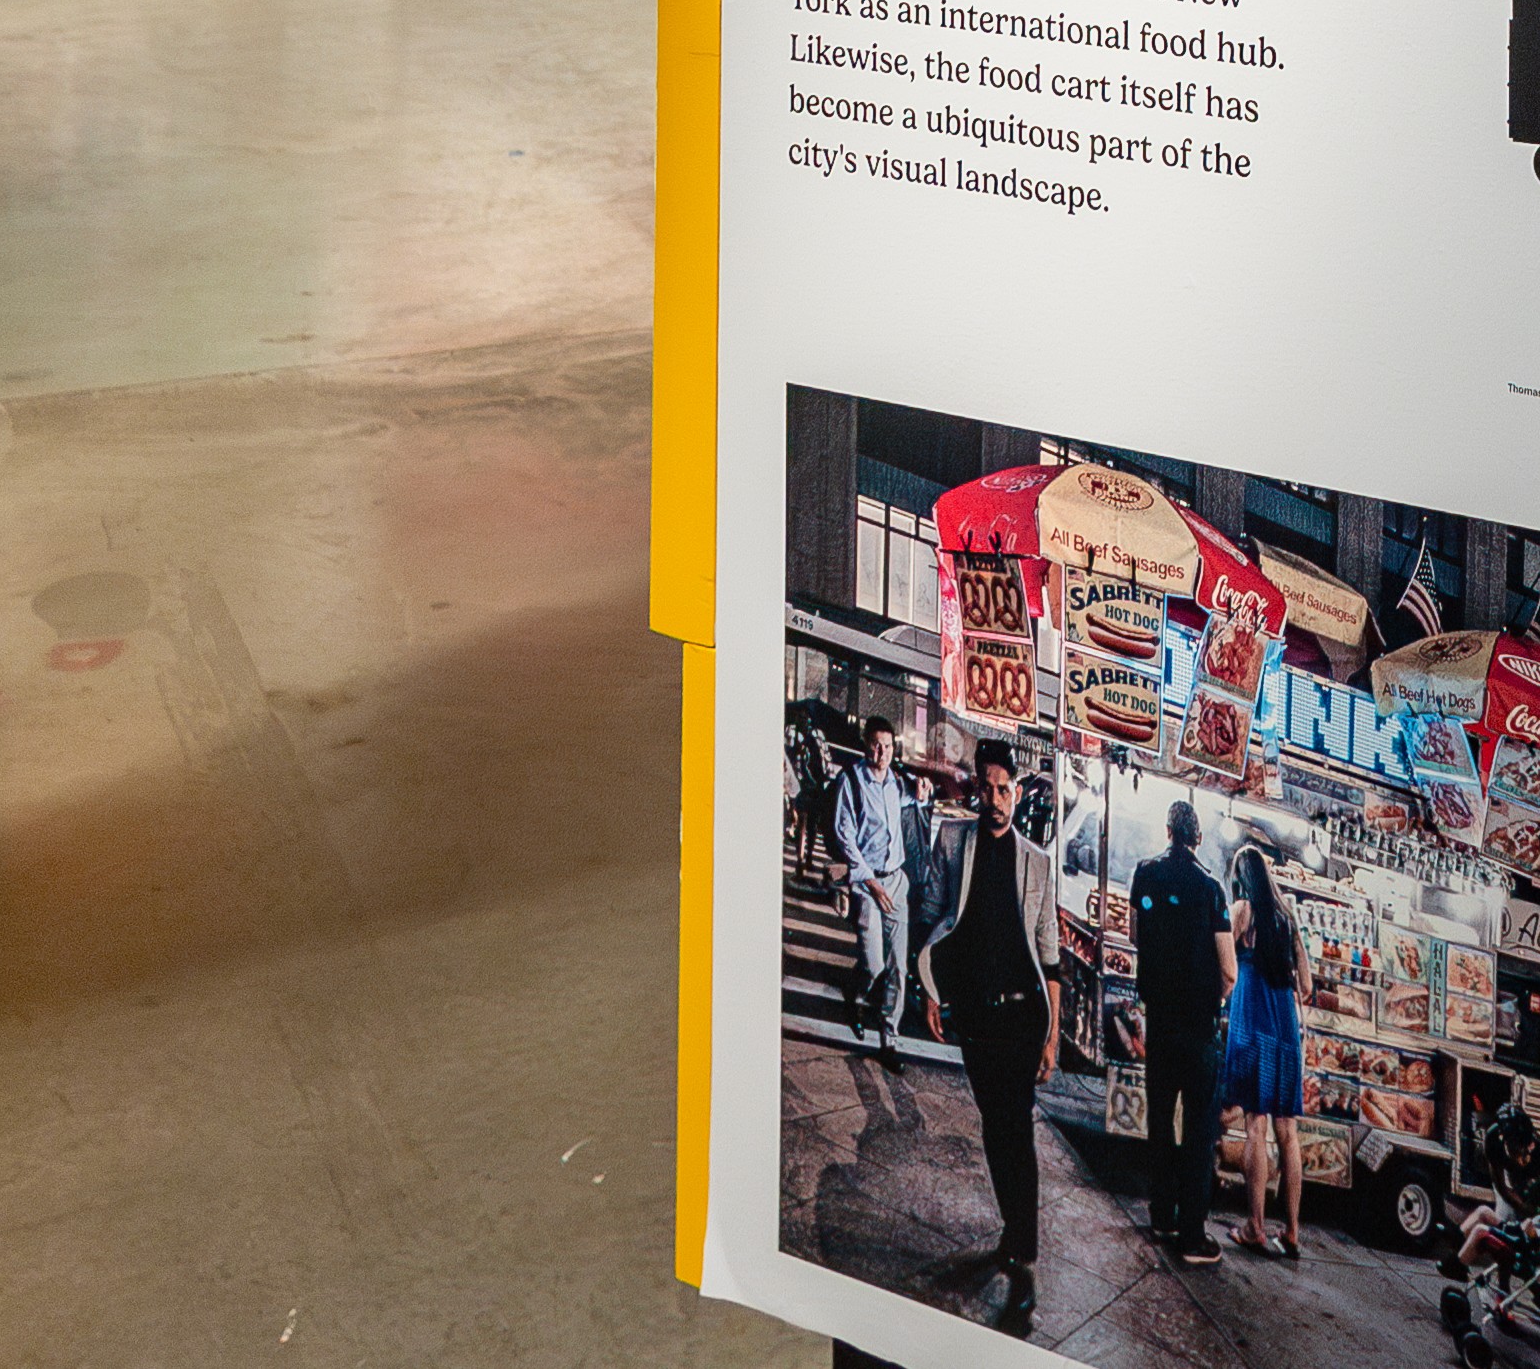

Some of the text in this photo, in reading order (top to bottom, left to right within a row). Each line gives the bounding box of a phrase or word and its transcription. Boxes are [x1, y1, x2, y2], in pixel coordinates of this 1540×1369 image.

[1050, 527, 1185, 580] All Beef Sausages
[1070, 584, 1161, 612] SABRETT
[1104, 604, 1160, 632] HOT DOG
[1068, 668, 1160, 694] SABRETT
[1102, 688, 1157, 716] HOT DOG
[1399, 685, 1475, 712] Beef Dogs
[1432, 943, 1443, 1033] HALAL
